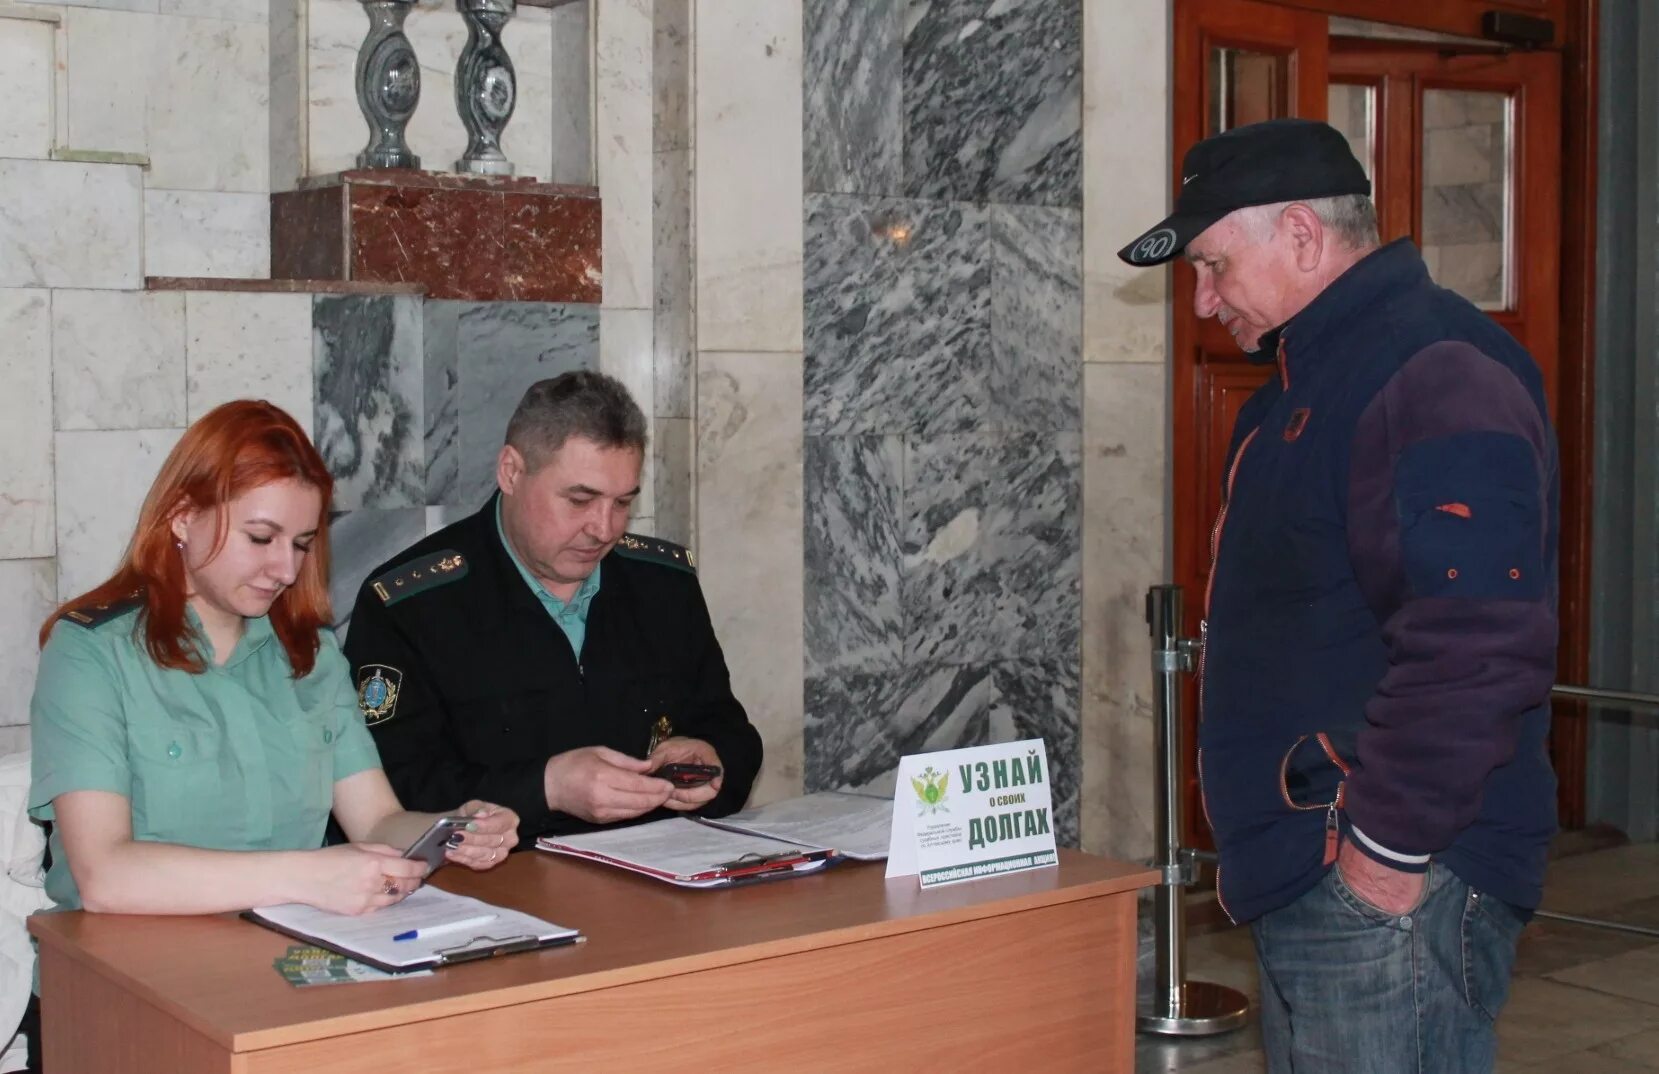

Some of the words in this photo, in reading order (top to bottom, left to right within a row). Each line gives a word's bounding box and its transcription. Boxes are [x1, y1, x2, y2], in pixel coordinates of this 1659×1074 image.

[1141, 237, 1168, 258] 90
[959, 749, 1043, 793] УЗНАЙ
[989, 797, 996, 807] О
[997, 793, 1026, 806] СВОИХ
[968, 807, 1050, 850] ДОЛГАХ
[922, 866, 973, 884] ВСЕРОССИЙСКАЯ
[973, 857, 1032, 875] ИНФОРМАЦИОННАЯ
